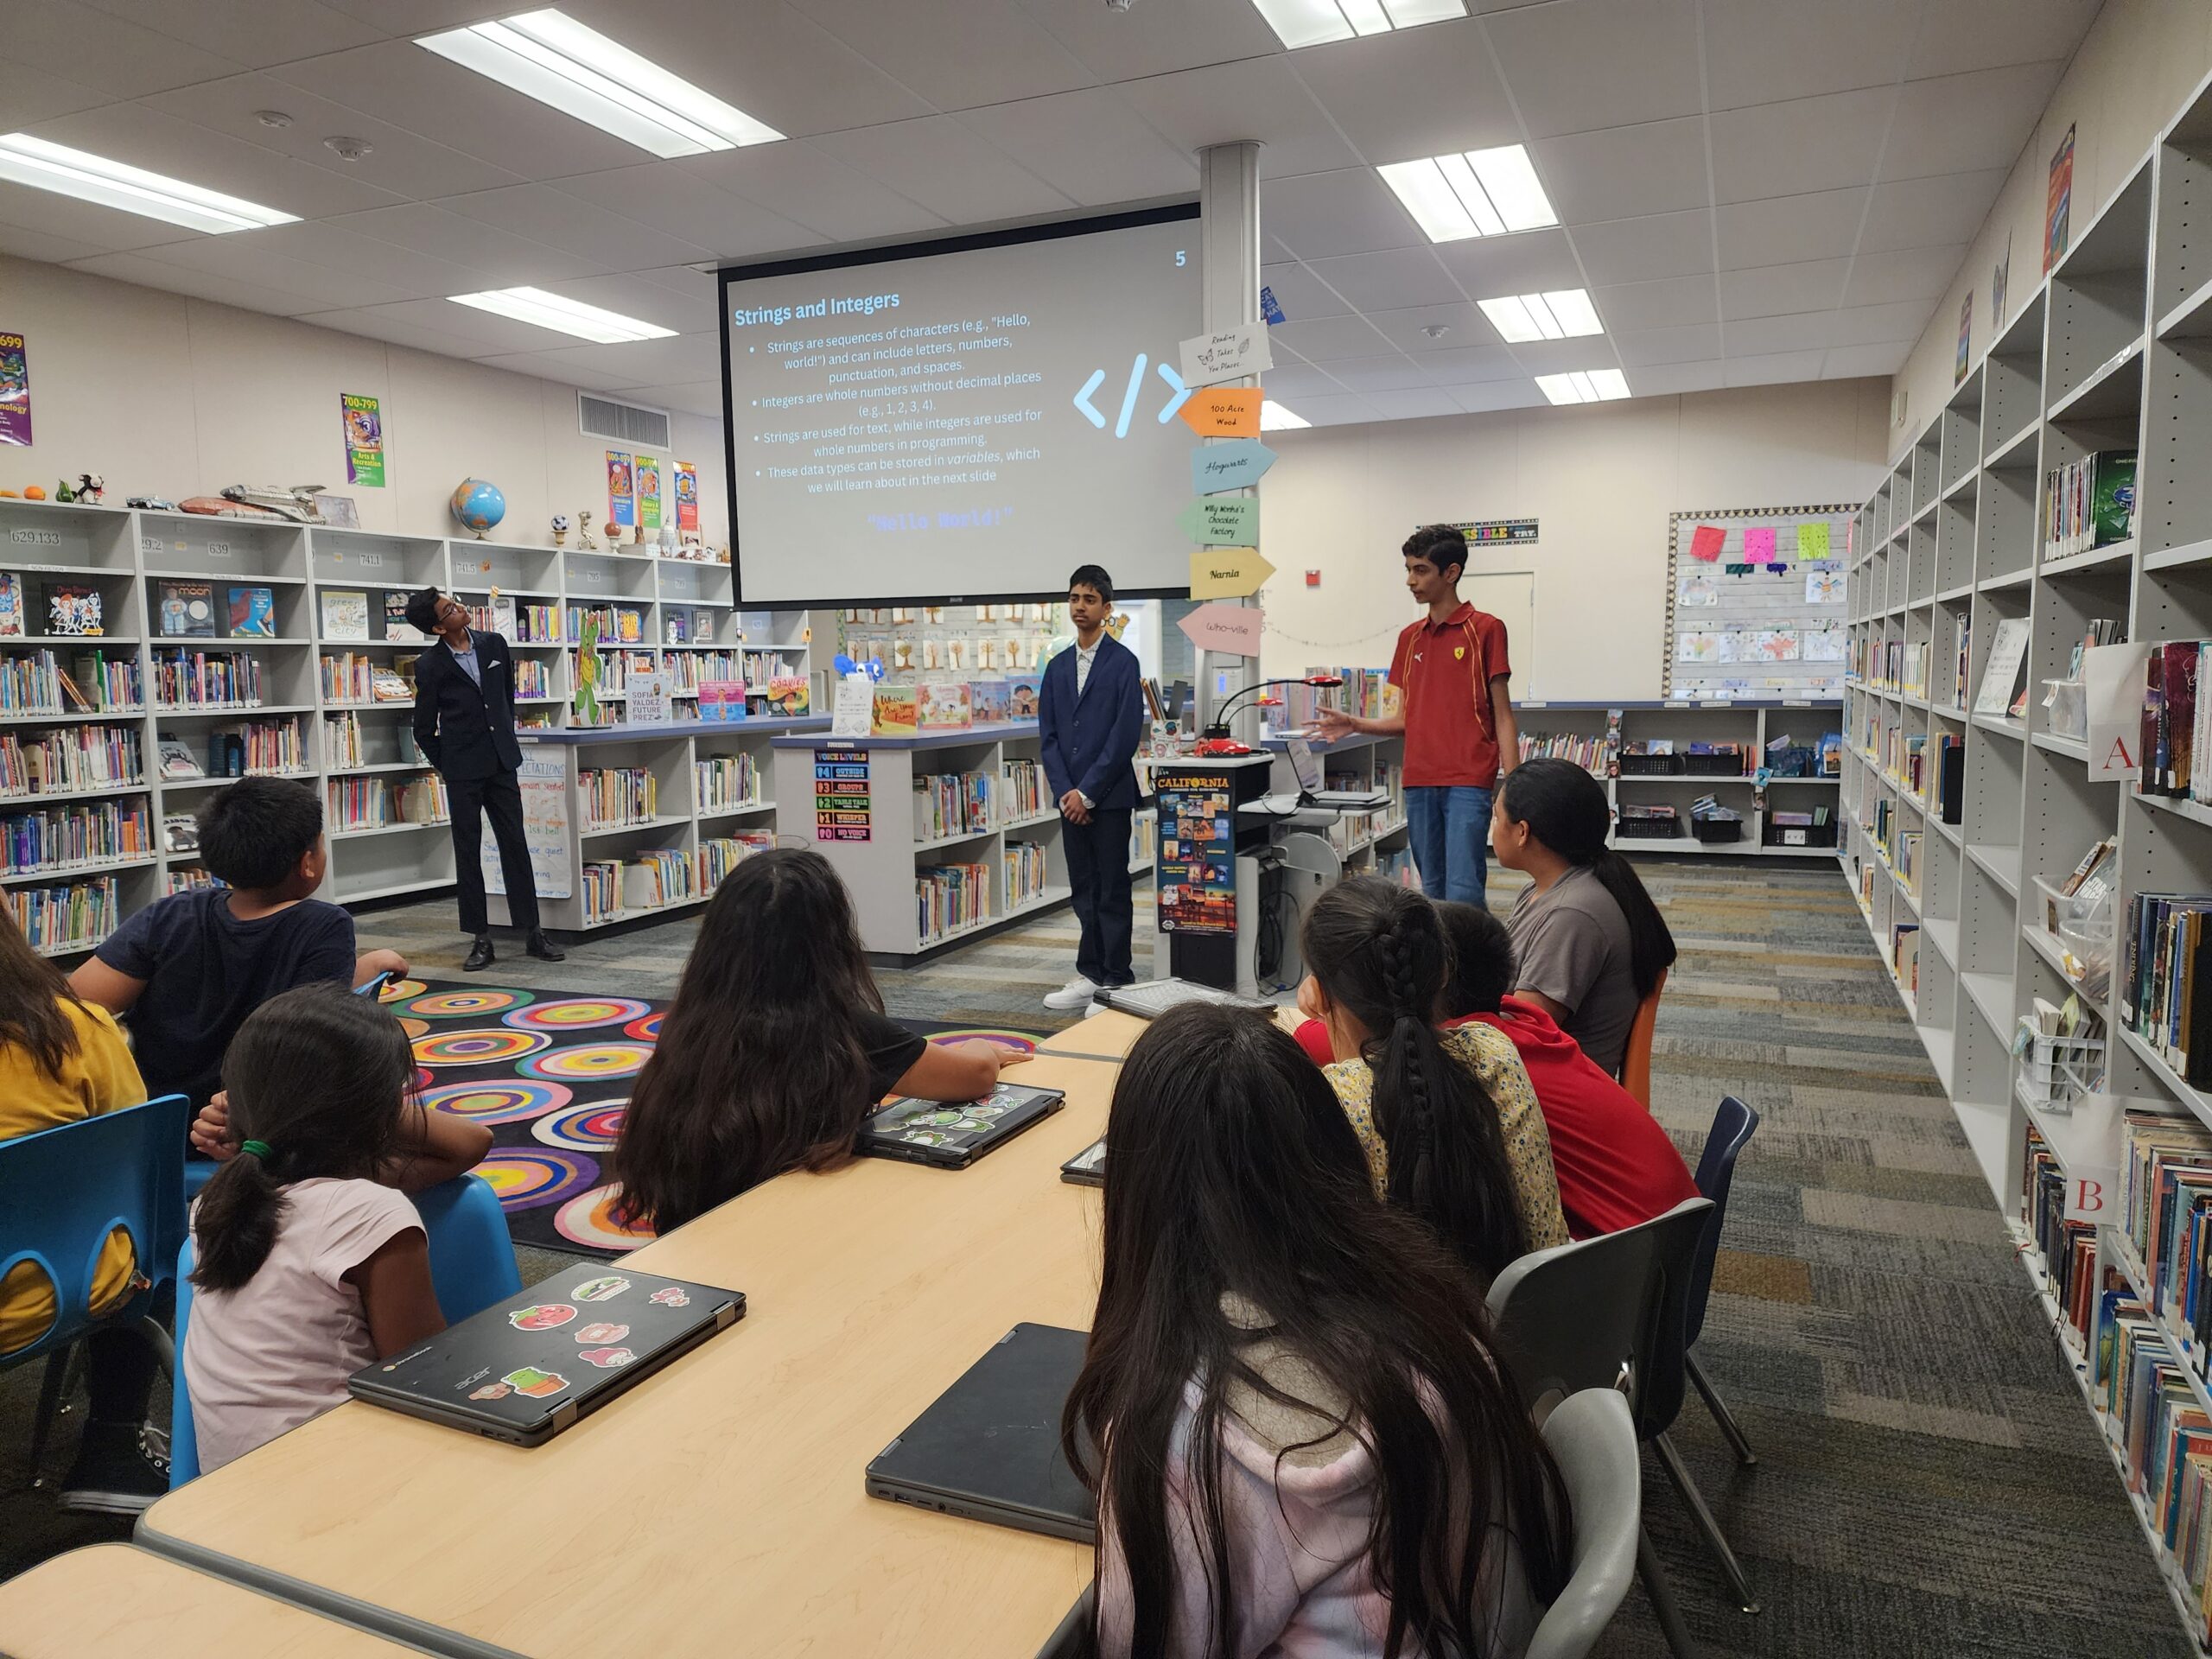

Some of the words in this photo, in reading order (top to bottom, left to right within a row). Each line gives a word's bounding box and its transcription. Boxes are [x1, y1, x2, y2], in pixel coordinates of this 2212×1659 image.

[1175, 251, 1186, 266] 5
[734, 305, 791, 326] Strings
[796, 299, 826, 319] and
[830, 293, 900, 315] Integers
[767, 339, 804, 353] Strings
[806, 338, 823, 349] are
[826, 332, 883, 346] sequences
[886, 327, 897, 340] of
[899, 322, 959, 339] characters
[962, 320, 988, 333] (e.g.,
[992, 314, 1030, 327] "Hello,
[784, 354, 826, 370] world!")
[829, 352, 849, 365] and
[851, 351, 870, 362] can
[873, 346, 913, 360] include
[916, 341, 955, 356] letters,
[958, 335, 1012, 351] numbers,
[829, 365, 897, 385] punctuation,
[900, 362, 920, 376] and
[924, 359, 965, 375] spaces.
[762, 394, 804, 409] Integers
[806, 393, 823, 404] are
[825, 389, 857, 402] whole
[860, 385, 908, 398] numbers
[911, 380, 953, 394] without
[956, 374, 1001, 389] decimal
[1004, 372, 1041, 387] places
[343, 396, 378, 410] 700-799
[887, 403, 896, 416] 1,
[898, 402, 907, 415] 2,
[910, 401, 919, 413] 3,
[923, 399, 936, 412] 4).
[764, 431, 800, 444] Strings
[802, 430, 819, 440] are
[821, 425, 846, 438] used
[849, 423, 864, 435] for
[867, 423, 891, 435] text,
[893, 418, 923, 432] while
[925, 416, 970, 430] integers
[973, 414, 992, 426] are
[995, 410, 1022, 424] used
[1025, 409, 1042, 421] for
[814, 444, 845, 457] whole
[847, 440, 894, 454] numbers
[897, 439, 907, 450] in
[910, 433, 987, 451] programming.
[767, 466, 798, 478] These
[800, 465, 824, 476] data
[826, 461, 855, 477] types
[857, 461, 877, 472] can
[880, 458, 893, 469] be
[896, 455, 931, 469] stored
[934, 454, 944, 465] in
[947, 450, 1003, 465] variables,
[1006, 447, 1040, 461] which
[808, 483, 823, 493] we
[825, 480, 843, 492] will
[846, 478, 872, 491] learn
[875, 476, 906, 488] about
[909, 475, 918, 486] in
[922, 474, 940, 485] the
[943, 473, 967, 484] next
[969, 470, 996, 483] slide
[12, 531, 60, 545] 629.133
[1211, 527, 1236, 538] Factory
[209, 543, 228, 556] 639
[1210, 569, 1240, 580] Narnia
[178, 587, 211, 595] moon
[2103, 736, 2135, 769] A
[825, 829, 832, 839] 0
[2075, 1179, 2103, 1211] B
[454, 1366, 490, 1389] acer
